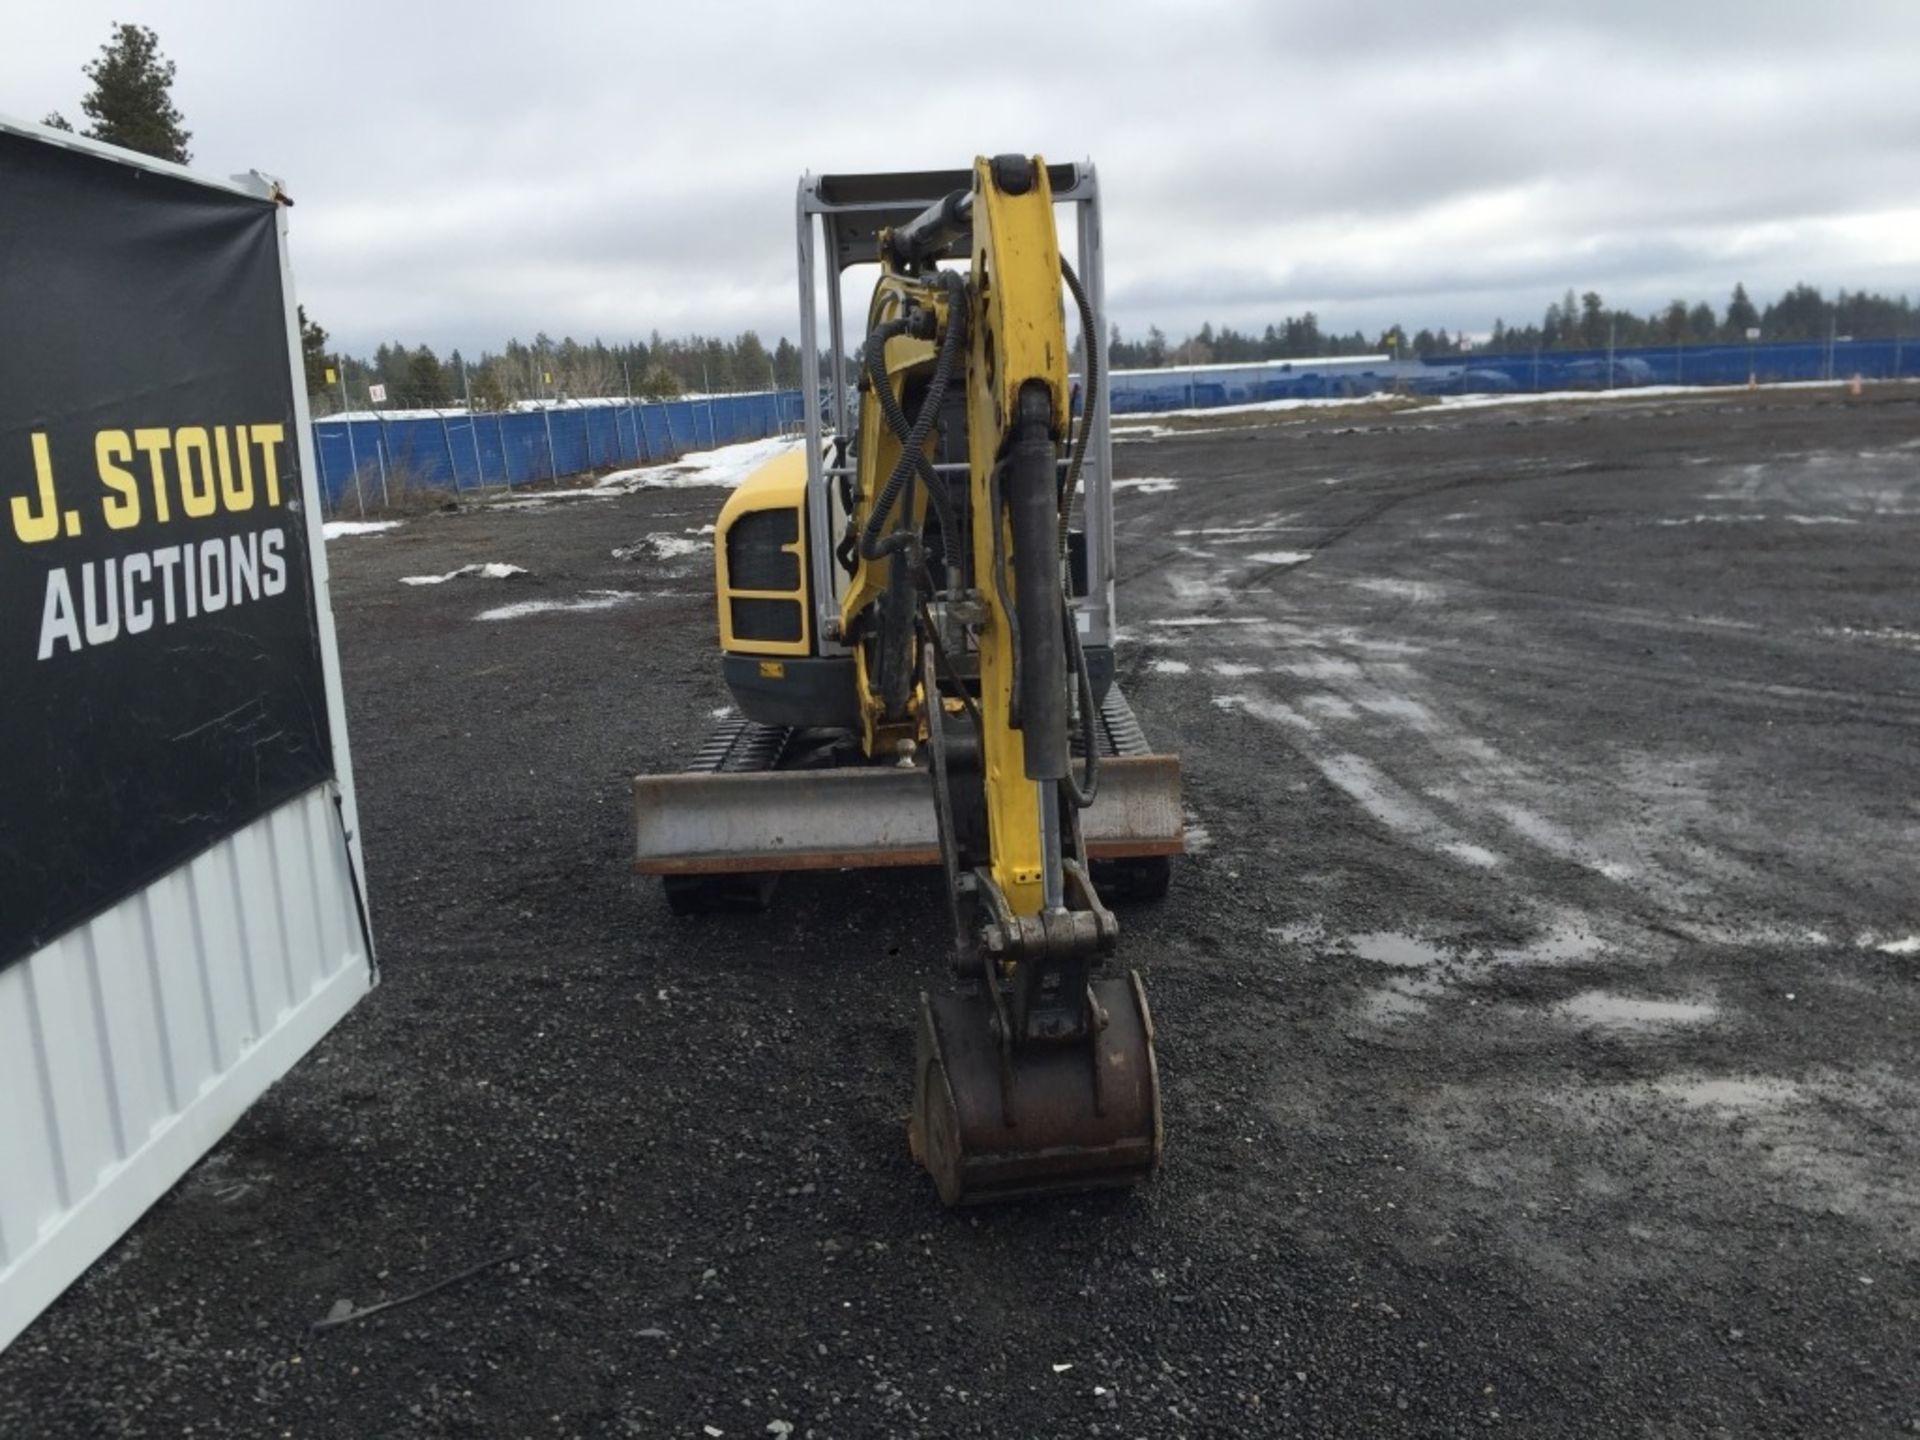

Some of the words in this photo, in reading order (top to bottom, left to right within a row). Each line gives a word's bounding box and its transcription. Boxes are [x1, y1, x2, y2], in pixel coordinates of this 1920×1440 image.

[10, 432, 81, 543] J.
[95, 424, 284, 530] STOUT
[37, 527, 287, 661] AUCTIONS
